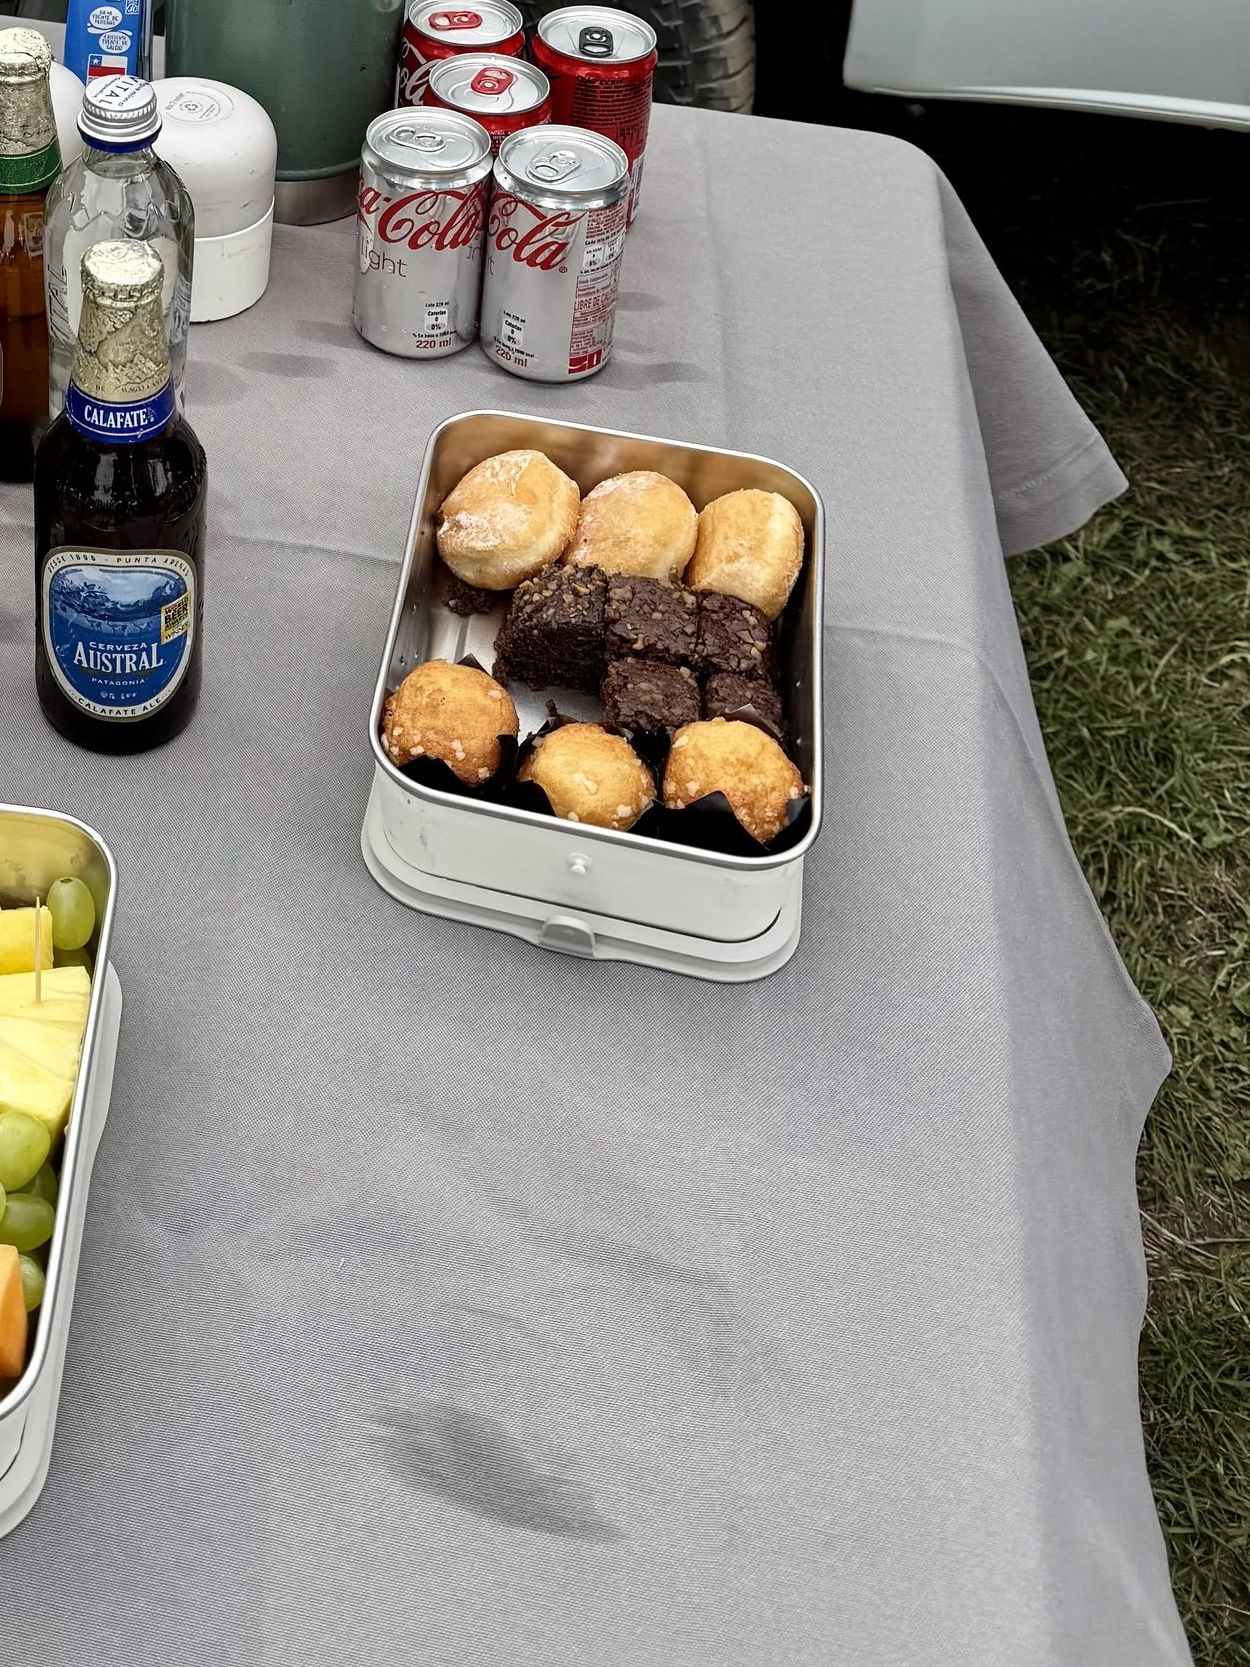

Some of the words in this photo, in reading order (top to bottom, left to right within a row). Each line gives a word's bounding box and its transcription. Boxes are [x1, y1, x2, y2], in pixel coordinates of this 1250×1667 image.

[574, 297, 592, 311] LIBRE
[592, 295, 601, 307] DE
[416, 339, 436, 349] 220
[439, 337, 452, 348] ml
[495, 347, 512, 361] 220
[514, 356, 528, 367] ml
[84, 404, 149, 429] CALAFATE
[48, 555, 67, 574] DESDE
[116, 556, 158, 564] PUNTA
[162, 559, 190, 577] ARENAS
[165, 603, 189, 625] BEER
[89, 641, 148, 651] CERVEZA
[73, 641, 163, 674] AUSTRAL
[91, 677, 146, 686] PATAGONIA
[78, 697, 138, 715] CALAFATE
[142, 697, 161, 713] ALE
